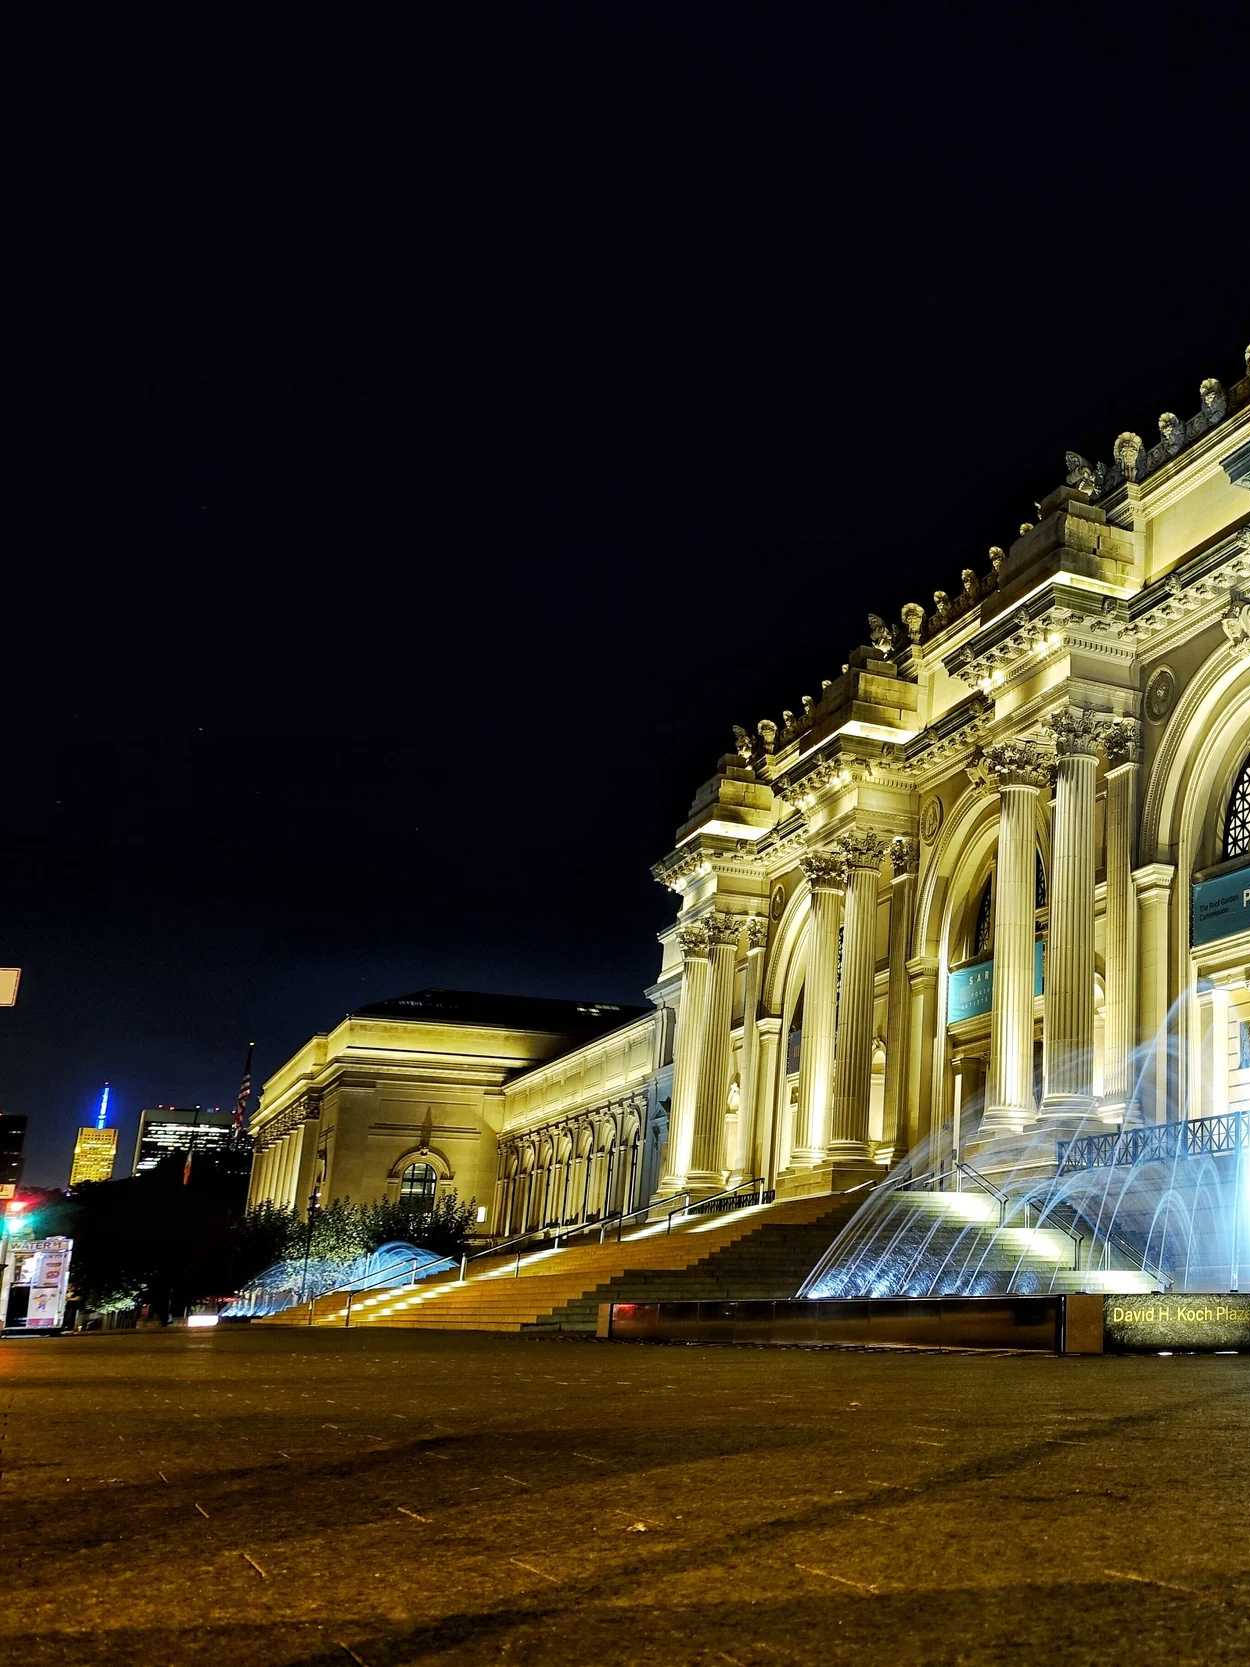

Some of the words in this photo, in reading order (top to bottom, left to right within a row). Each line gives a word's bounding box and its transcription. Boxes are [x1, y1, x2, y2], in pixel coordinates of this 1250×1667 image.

[1200, 904, 1209, 912] The
[1209, 900, 1220, 909] Roof
[1221, 895, 1239, 906] Garden
[1200, 907, 1228, 921] Commission
[11, 1241, 51, 1249] WATER
[1113, 1306, 1154, 1322] David
[1158, 1306, 1173, 1321] H.
[1177, 1306, 1212, 1321] Koch
